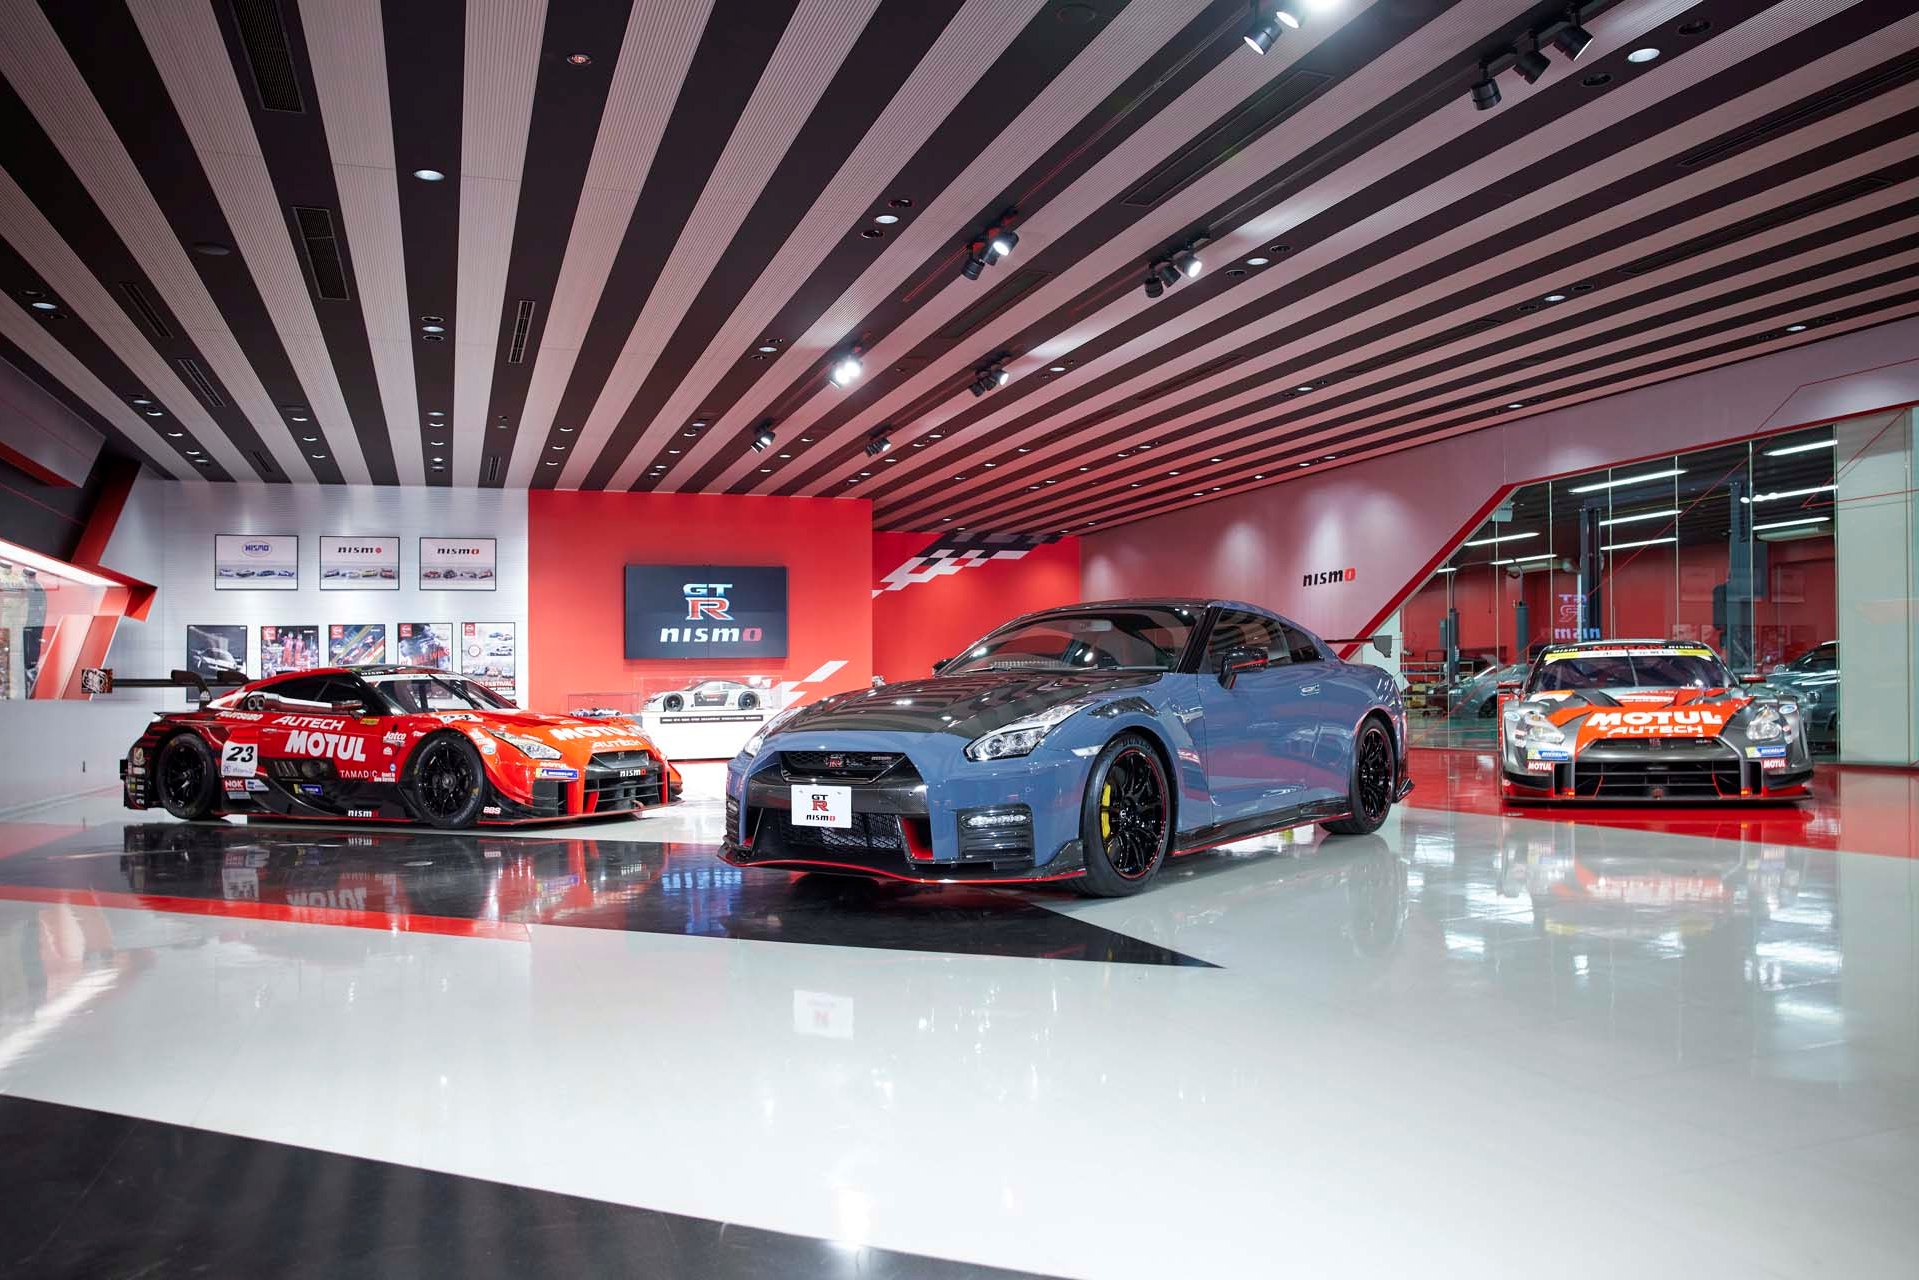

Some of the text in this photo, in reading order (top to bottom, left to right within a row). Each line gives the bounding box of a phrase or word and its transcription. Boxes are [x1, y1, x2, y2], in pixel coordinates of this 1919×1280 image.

[1303, 567, 1356, 587] nismo
[683, 583, 733, 597] GT
[685, 597, 735, 620] R
[660, 627, 763, 643] nismo
[272, 715, 346, 731] AUTECH
[1586, 711, 1723, 727] MOTUL
[1607, 725, 1704, 735] AUTECH
[284, 729, 367, 763] MOTUL
[226, 746, 255, 763] 23
[1528, 761, 1552, 770] MOTUL
[620, 769, 647, 778] nismo
[483, 806, 501, 815] BBS
[812, 800, 829, 812] R
[347, 809, 380, 818] nismo
[806, 814, 836, 822] nismo
